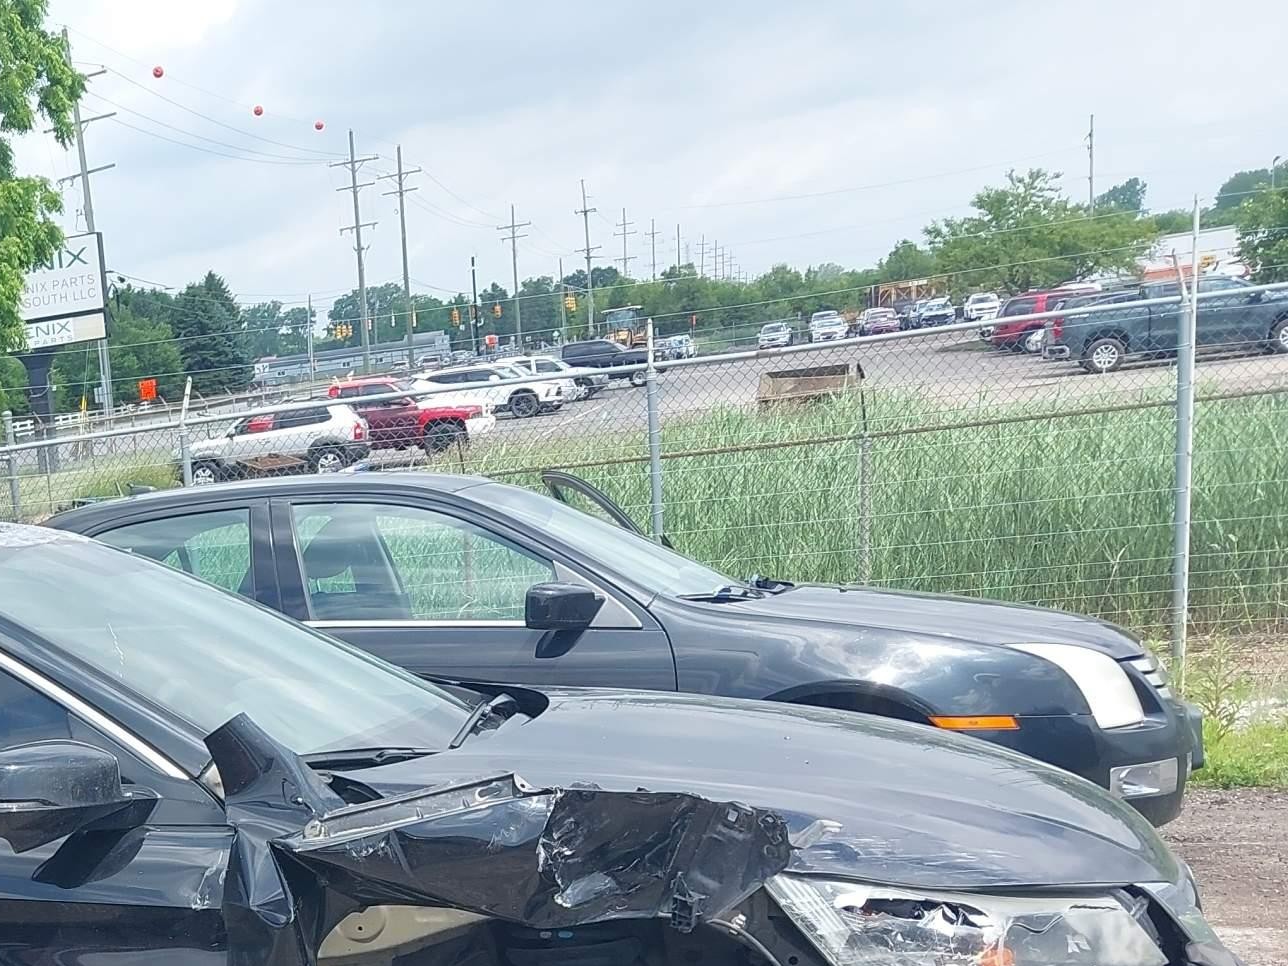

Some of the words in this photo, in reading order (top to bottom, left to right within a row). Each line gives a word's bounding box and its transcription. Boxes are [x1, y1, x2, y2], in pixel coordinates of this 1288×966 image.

[30, 246, 89, 273] NIX
[25, 281, 48, 294] NIX
[52, 274, 95, 290] PARTS
[23, 292, 68, 309] SOUTH
[72, 287, 97, 302] LLC
